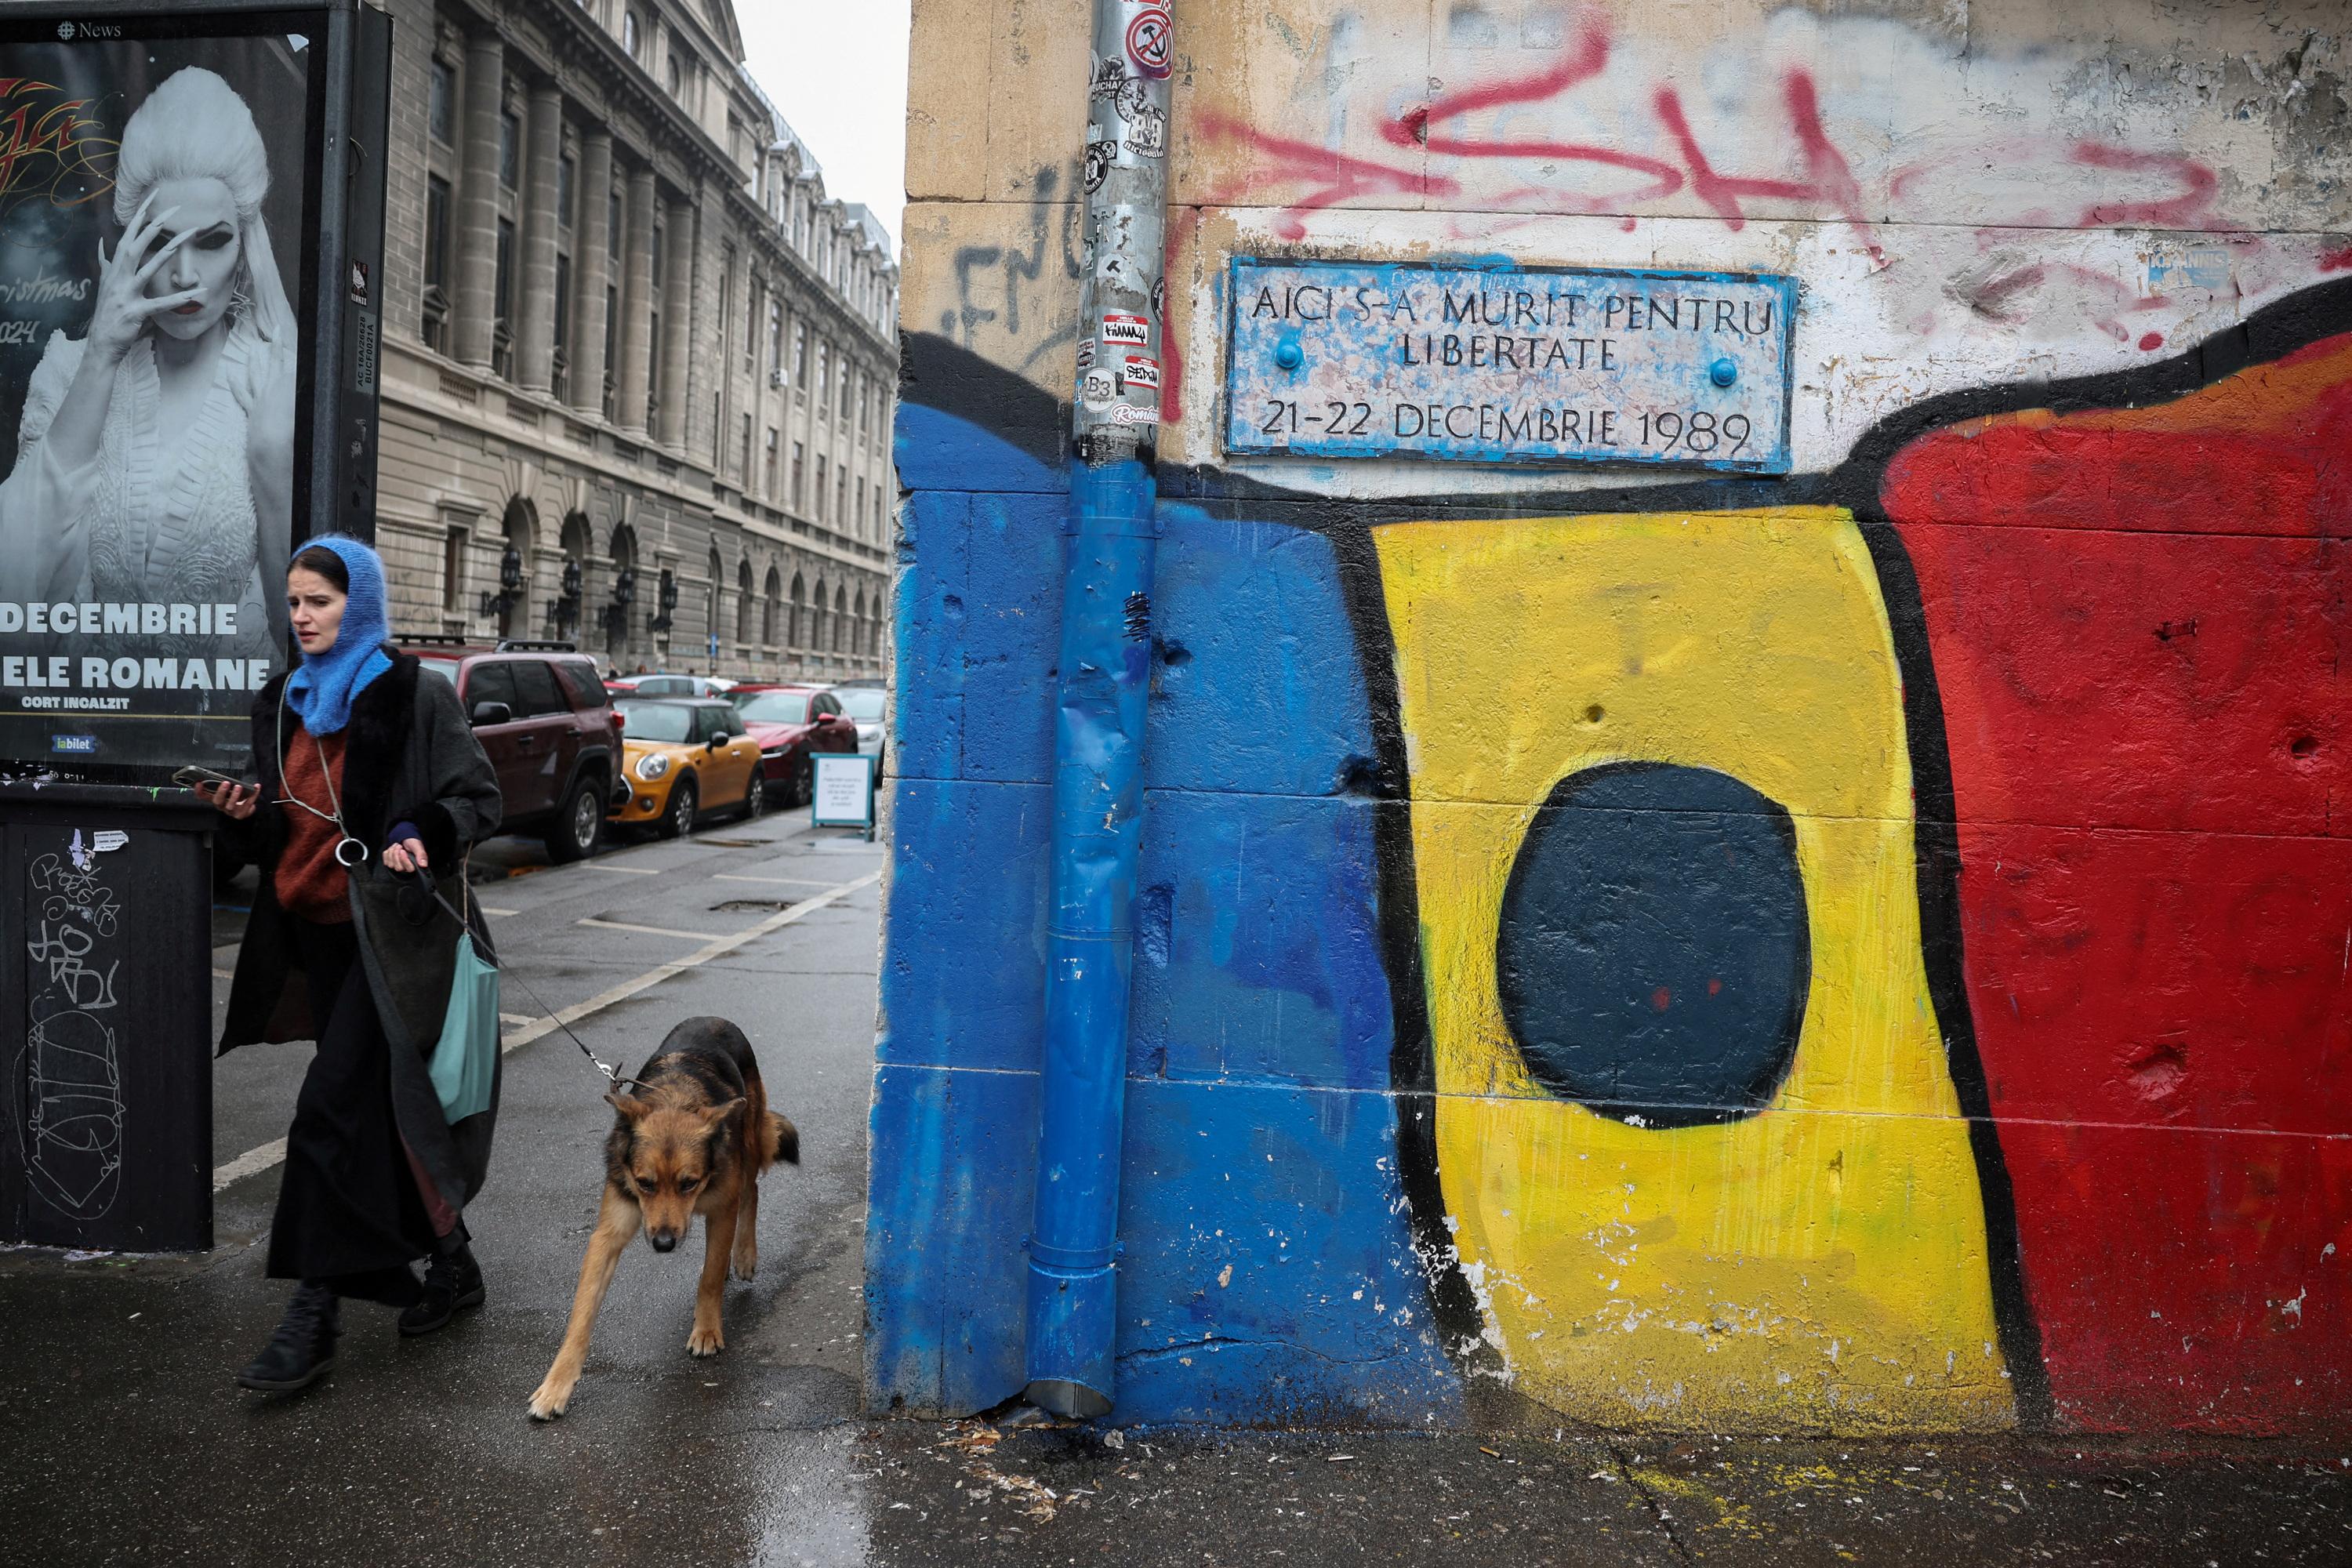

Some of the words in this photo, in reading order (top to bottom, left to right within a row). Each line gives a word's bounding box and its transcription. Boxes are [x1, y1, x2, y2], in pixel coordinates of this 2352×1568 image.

[79, 22, 121, 38] News
[1252, 286, 1332, 321] AICI
[1355, 286, 1417, 321] S-A
[1443, 288, 1588, 328] MURIT
[1605, 295, 1772, 336] PENTRU
[1403, 332, 1616, 371] LIBERTATE
[358, 371, 364, 387] AC
[1087, 376, 1111, 397] B3
[1261, 400, 1372, 436] 21-22
[1394, 403, 1617, 446] DECEMBRIE
[1639, 412, 1752, 455] 1989
[0, 601, 238, 634] DECEMBRIE
[3, 656, 70, 688] ELE
[82, 657, 270, 690] ROMANE
[21, 696, 60, 709] CORT
[64, 696, 129, 710] INCALZIT
[56, 737, 90, 750] iabilet
